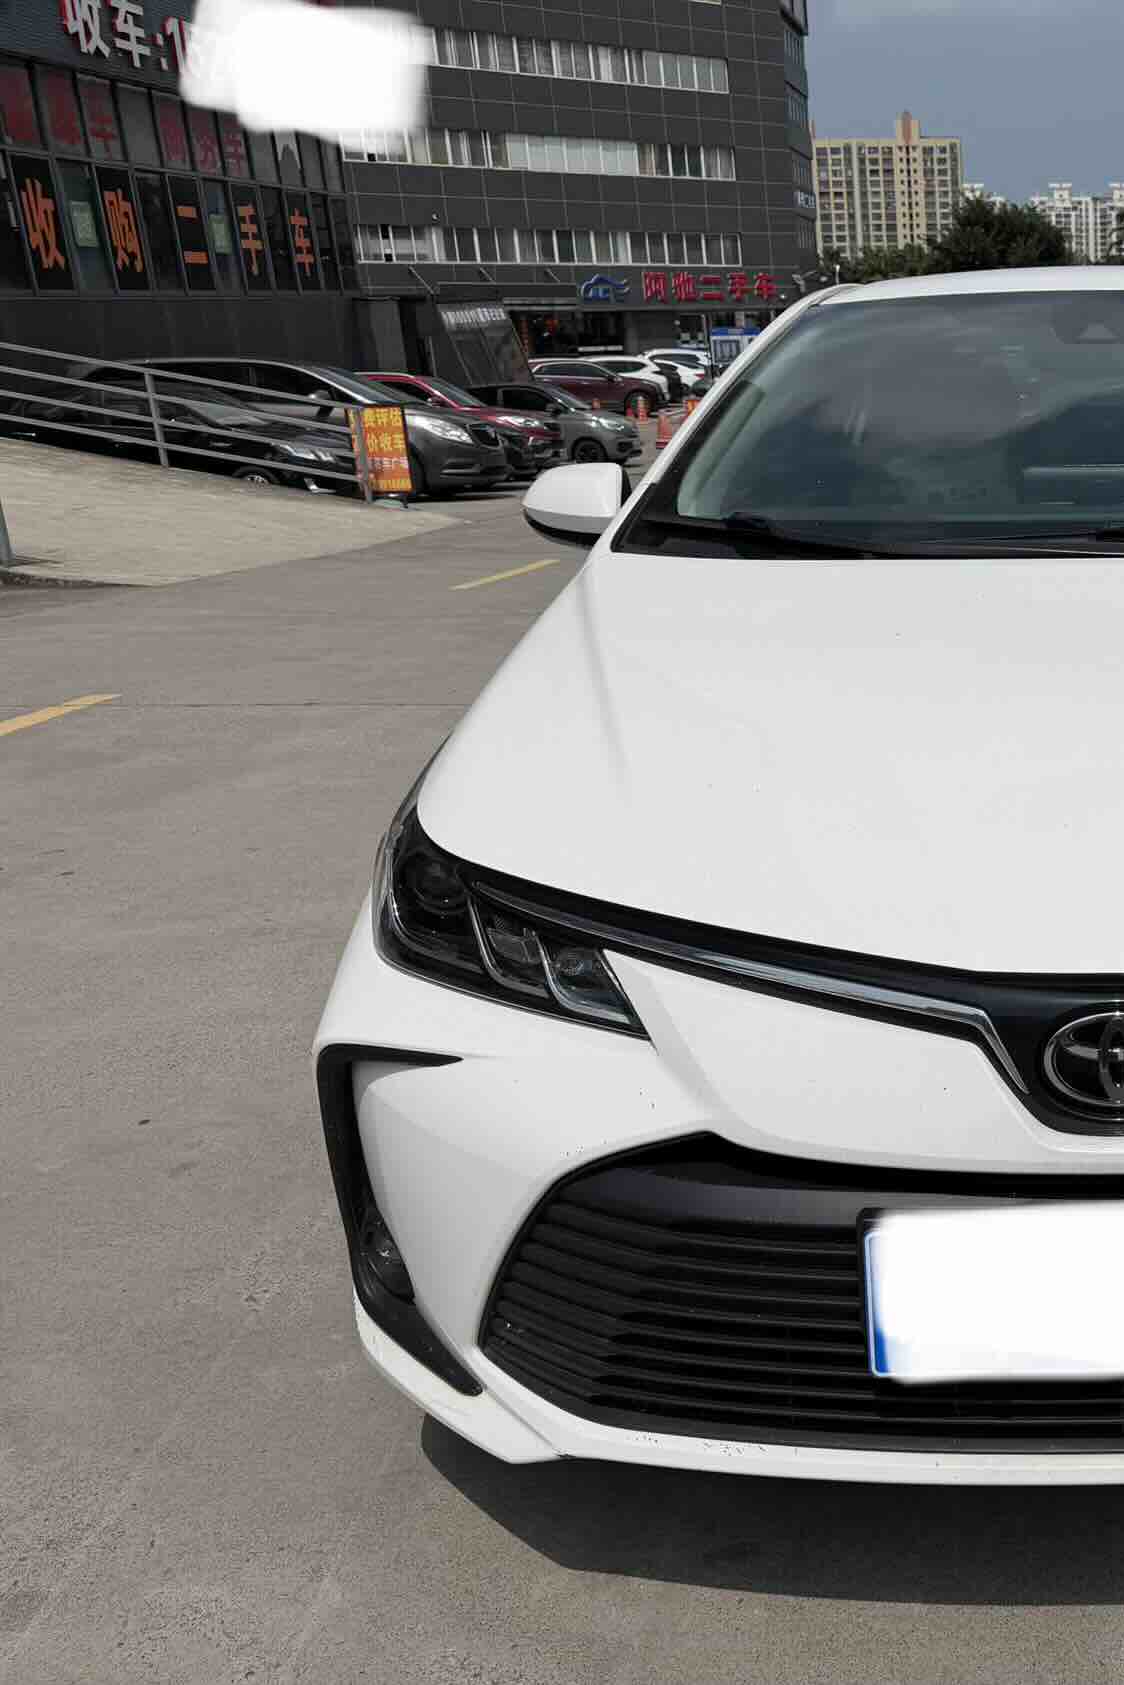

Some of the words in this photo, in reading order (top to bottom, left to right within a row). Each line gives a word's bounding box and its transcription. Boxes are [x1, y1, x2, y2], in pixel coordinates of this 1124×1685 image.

[62, 0, 195, 77] 收车:1
[21, 178, 315, 276] 收购二手车
